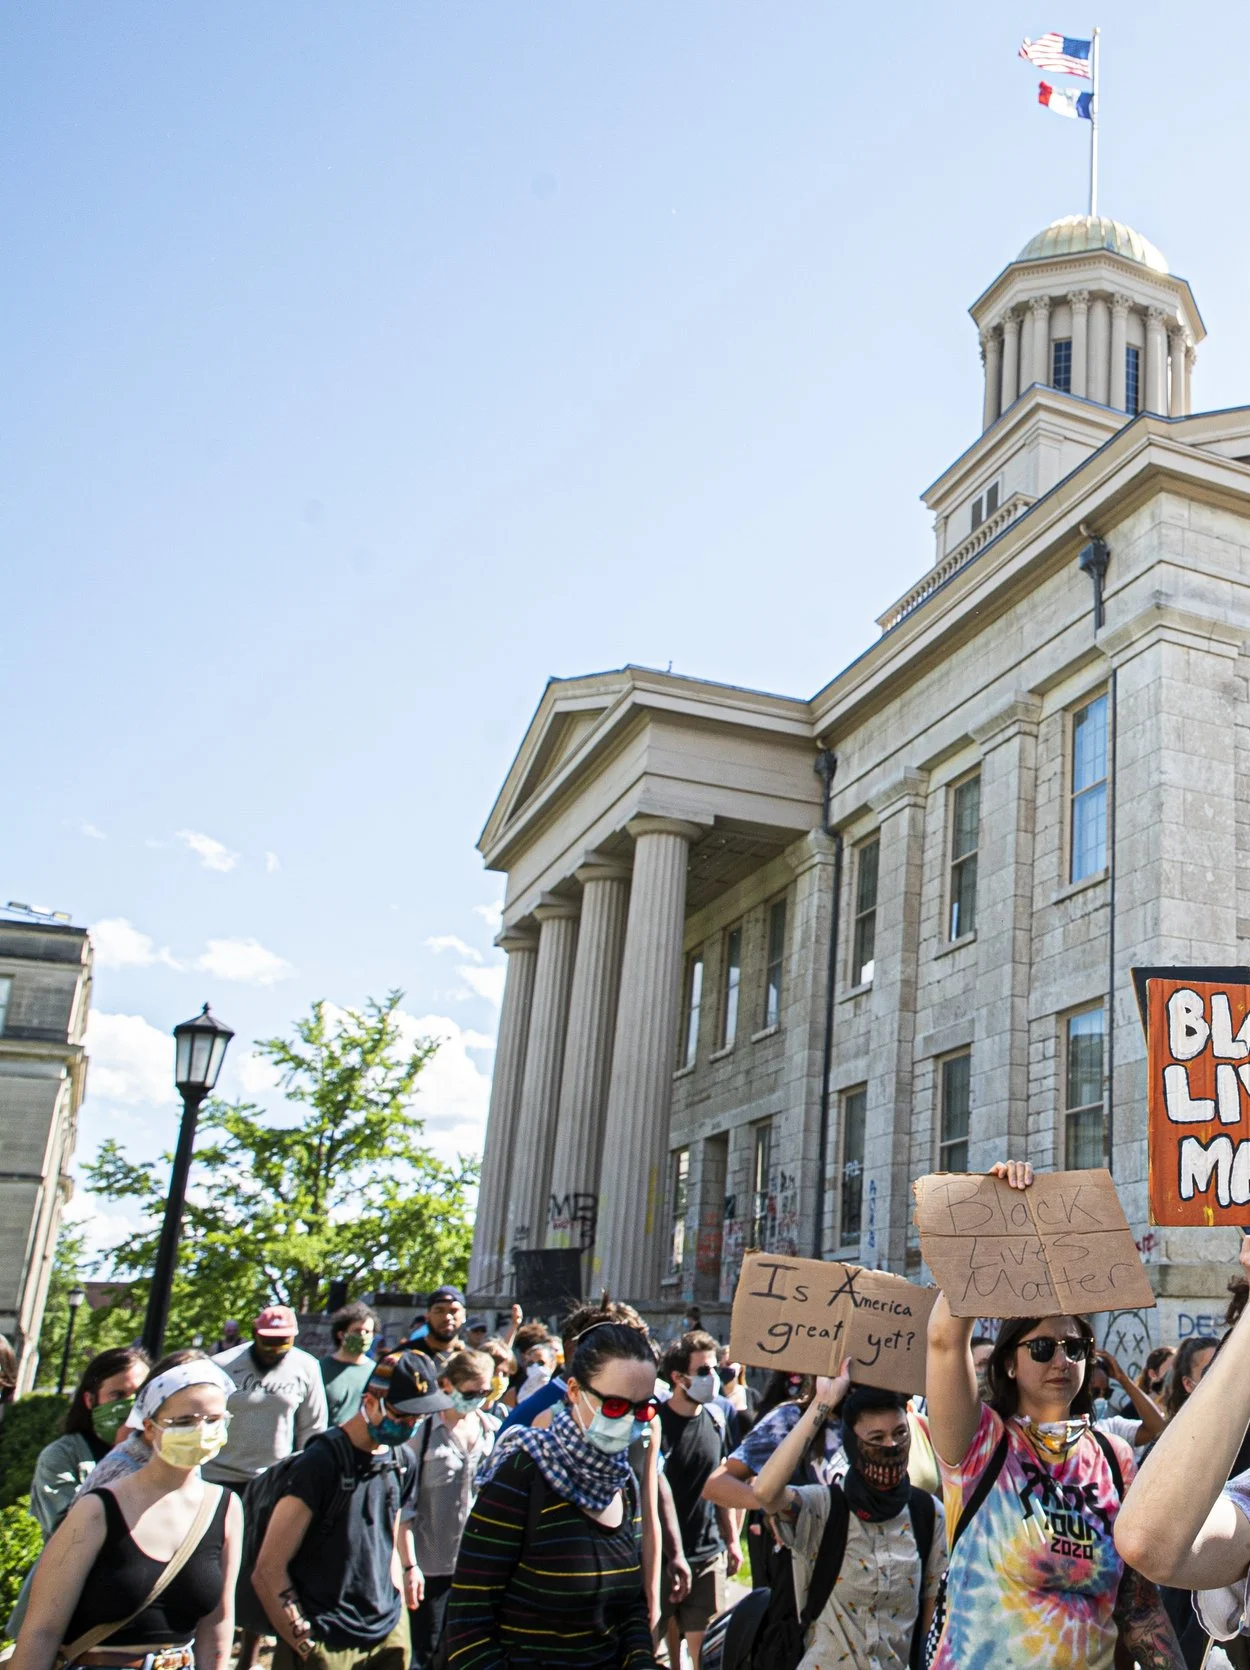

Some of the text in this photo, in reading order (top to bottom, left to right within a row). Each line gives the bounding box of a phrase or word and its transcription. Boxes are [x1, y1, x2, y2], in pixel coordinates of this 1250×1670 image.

[932, 1180, 1103, 1233] Black
[969, 1234, 1090, 1270] Lives
[751, 1263, 912, 1318] Is America
[962, 1263, 1134, 1301] Matter
[757, 1321, 916, 1367] great yet?
[1050, 1536, 1094, 1560] 2020
